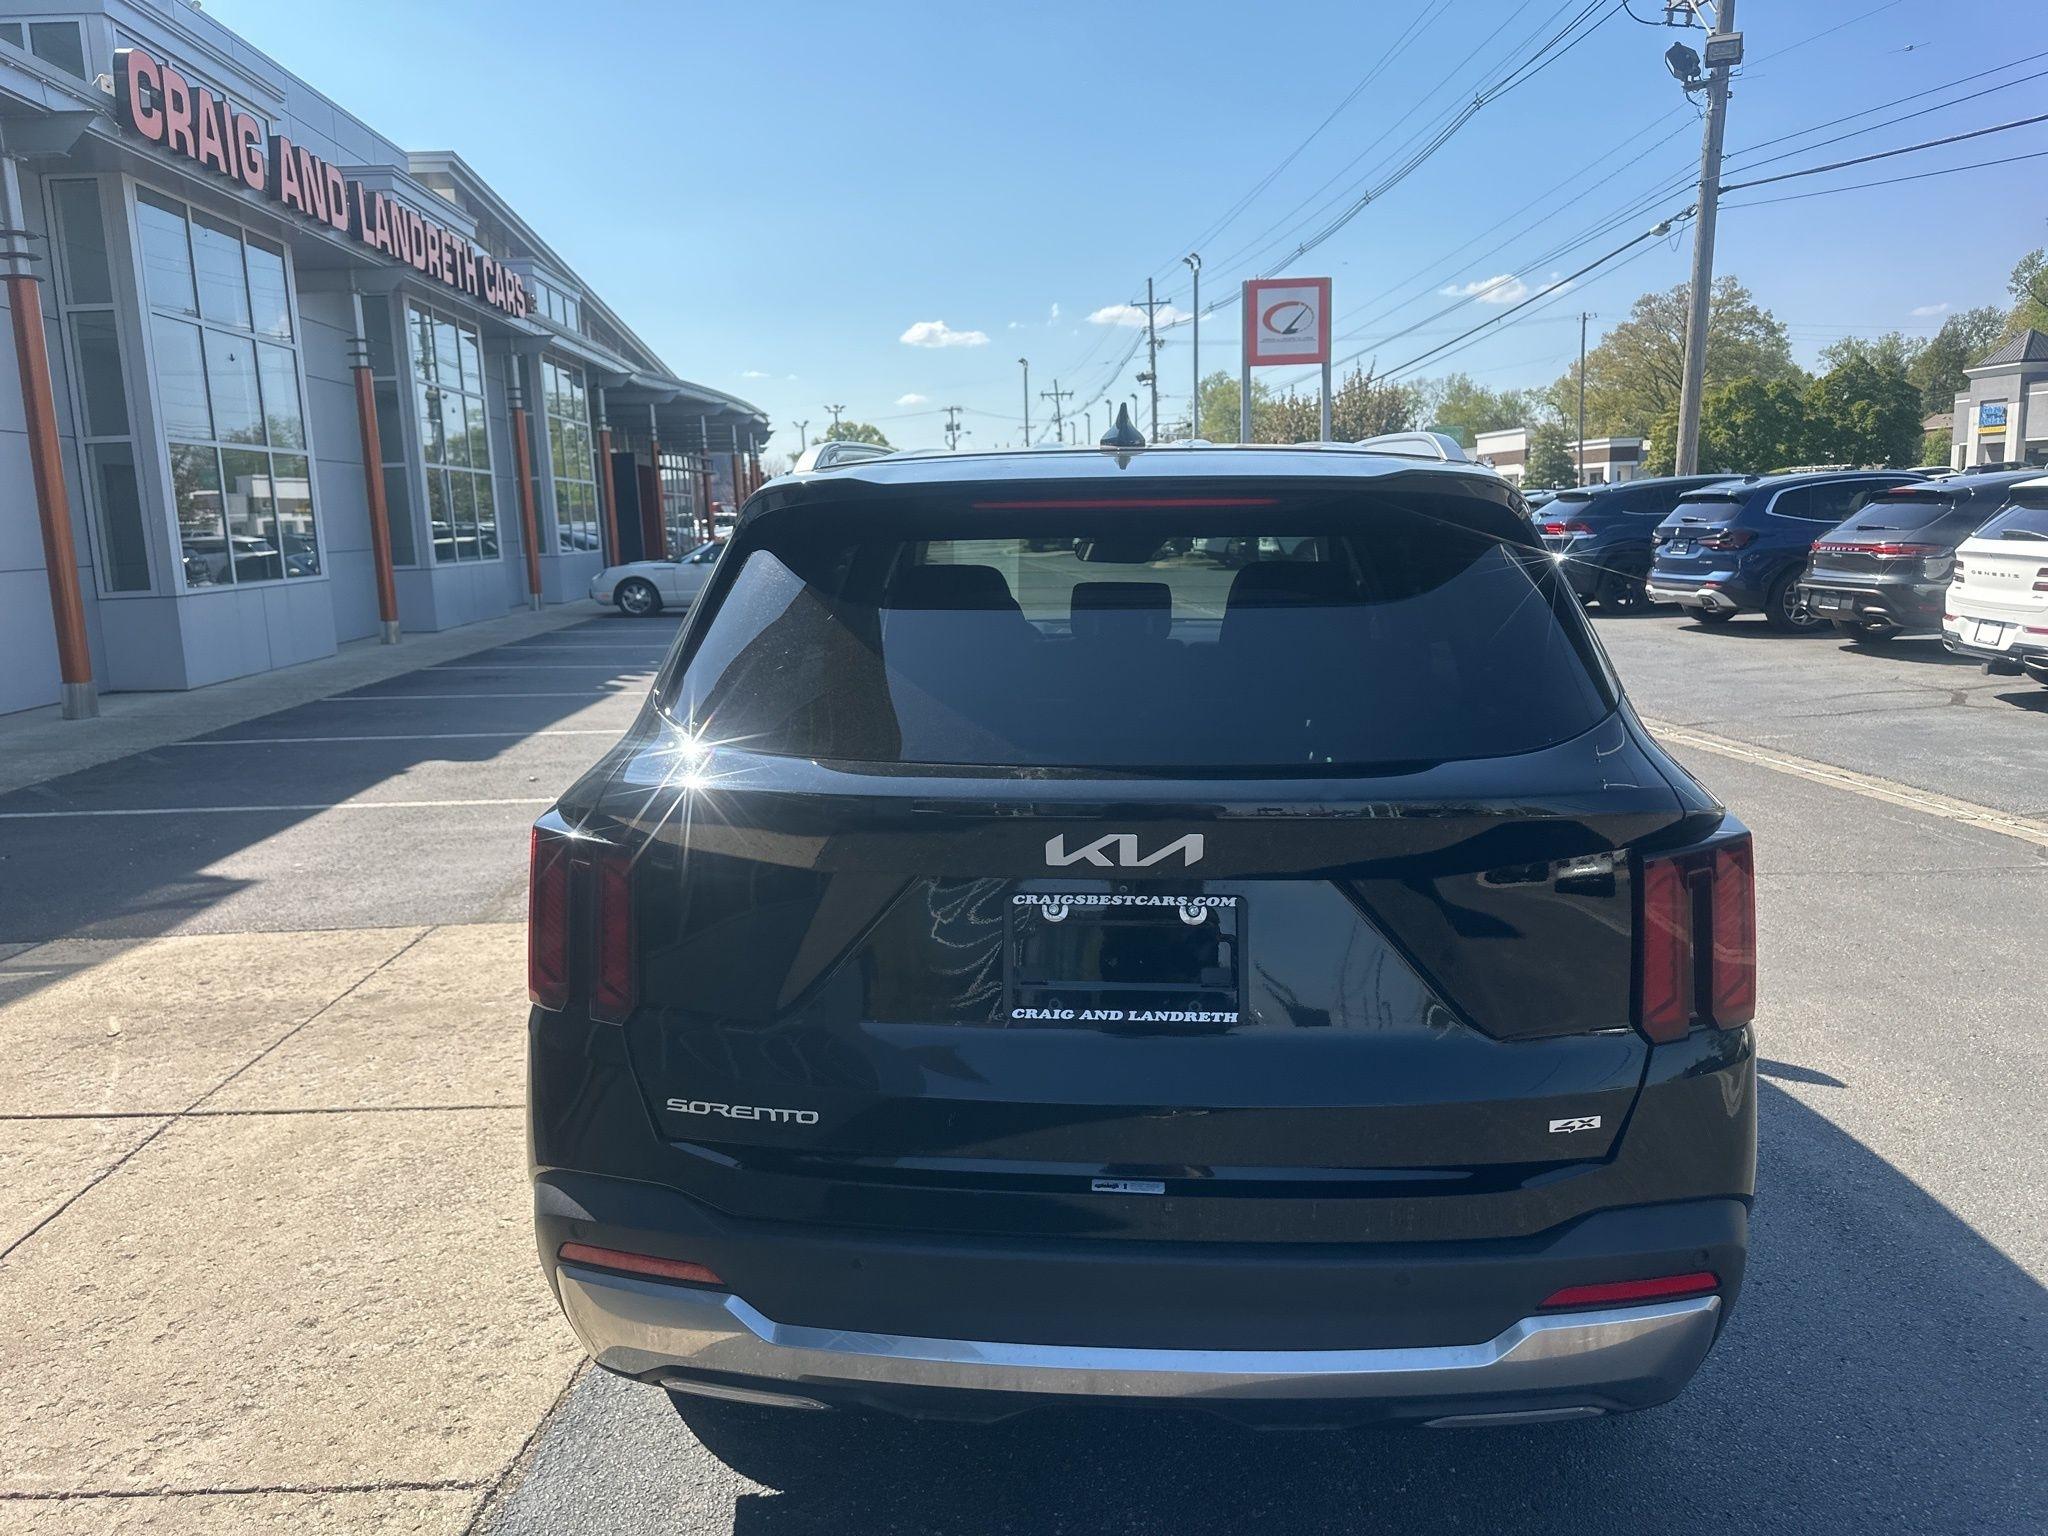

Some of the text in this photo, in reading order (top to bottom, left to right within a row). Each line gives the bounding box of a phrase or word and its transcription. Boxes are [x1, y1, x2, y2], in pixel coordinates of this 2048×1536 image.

[126, 47, 527, 319] CRAIG AND LANDRETH CARS
[1045, 833, 1204, 867] KIA
[1012, 894, 1238, 908] CRAIGSBESTCARS.COM
[1011, 1008, 1239, 1023] CRAIG AND LANDRETH
[666, 1098, 820, 1125] SORENTO
